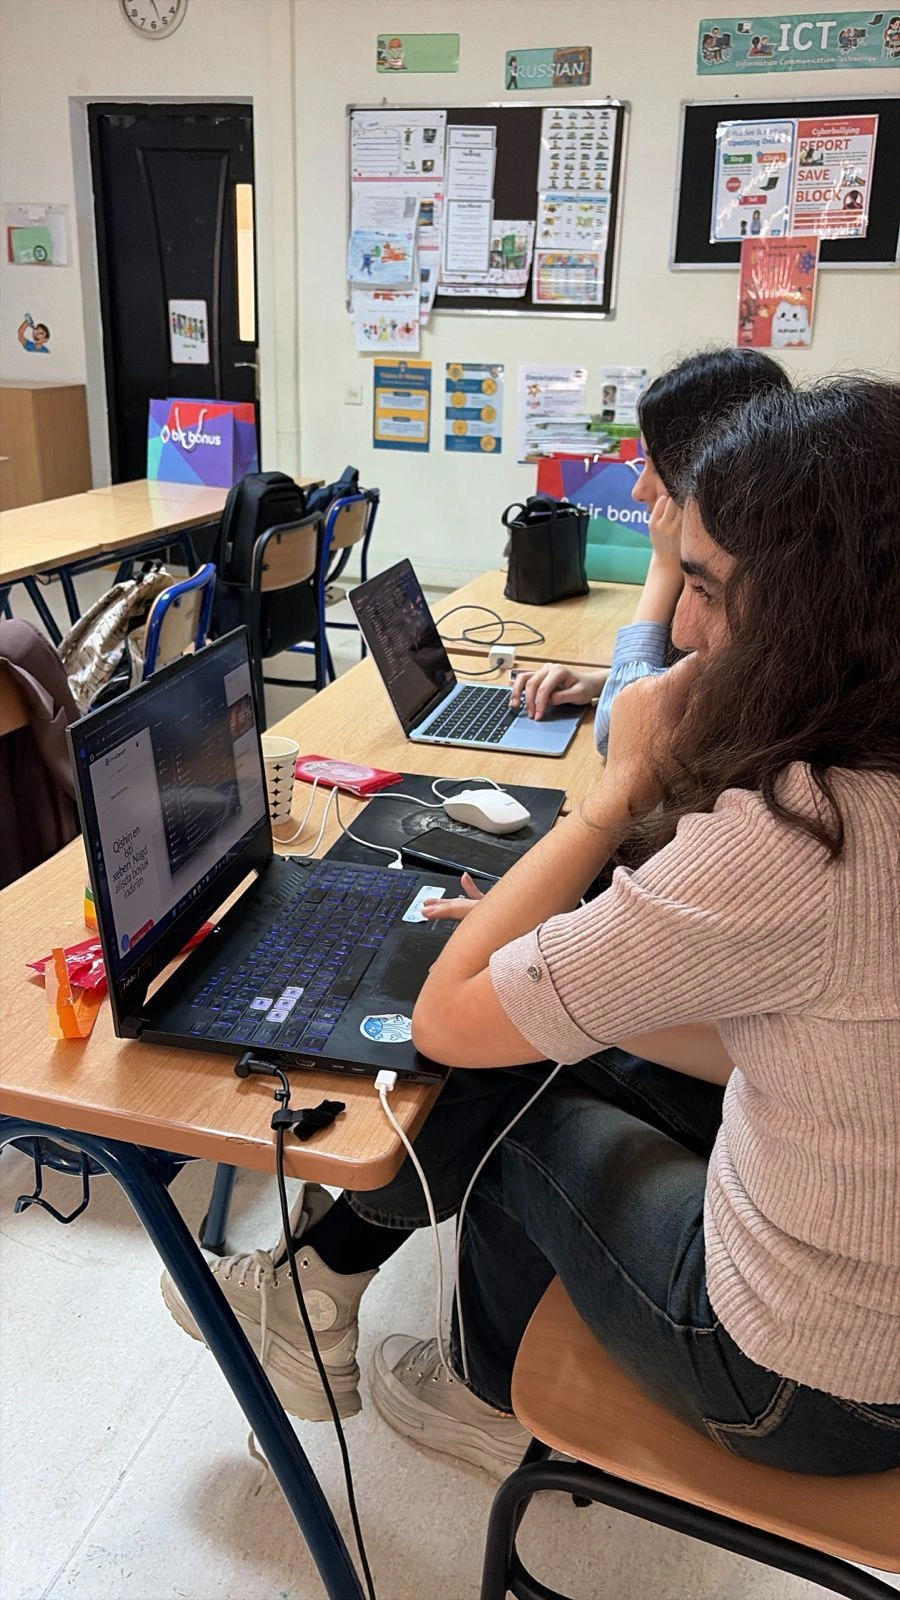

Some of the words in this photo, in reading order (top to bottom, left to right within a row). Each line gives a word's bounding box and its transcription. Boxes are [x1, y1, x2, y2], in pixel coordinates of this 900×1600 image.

[151, 21, 157, 29] 6
[162, 16, 168, 25] 5
[778, 21, 837, 52] ICT
[516, 62, 585, 78] RUSSIAN
[811, 127, 860, 137] Cyberbullying
[800, 139, 852, 152] REPORT
[798, 169, 830, 181] SAVE
[796, 189, 841, 203] BLOCK
[188, 430, 222, 446] bonus
[607, 505, 653, 524] bonu
